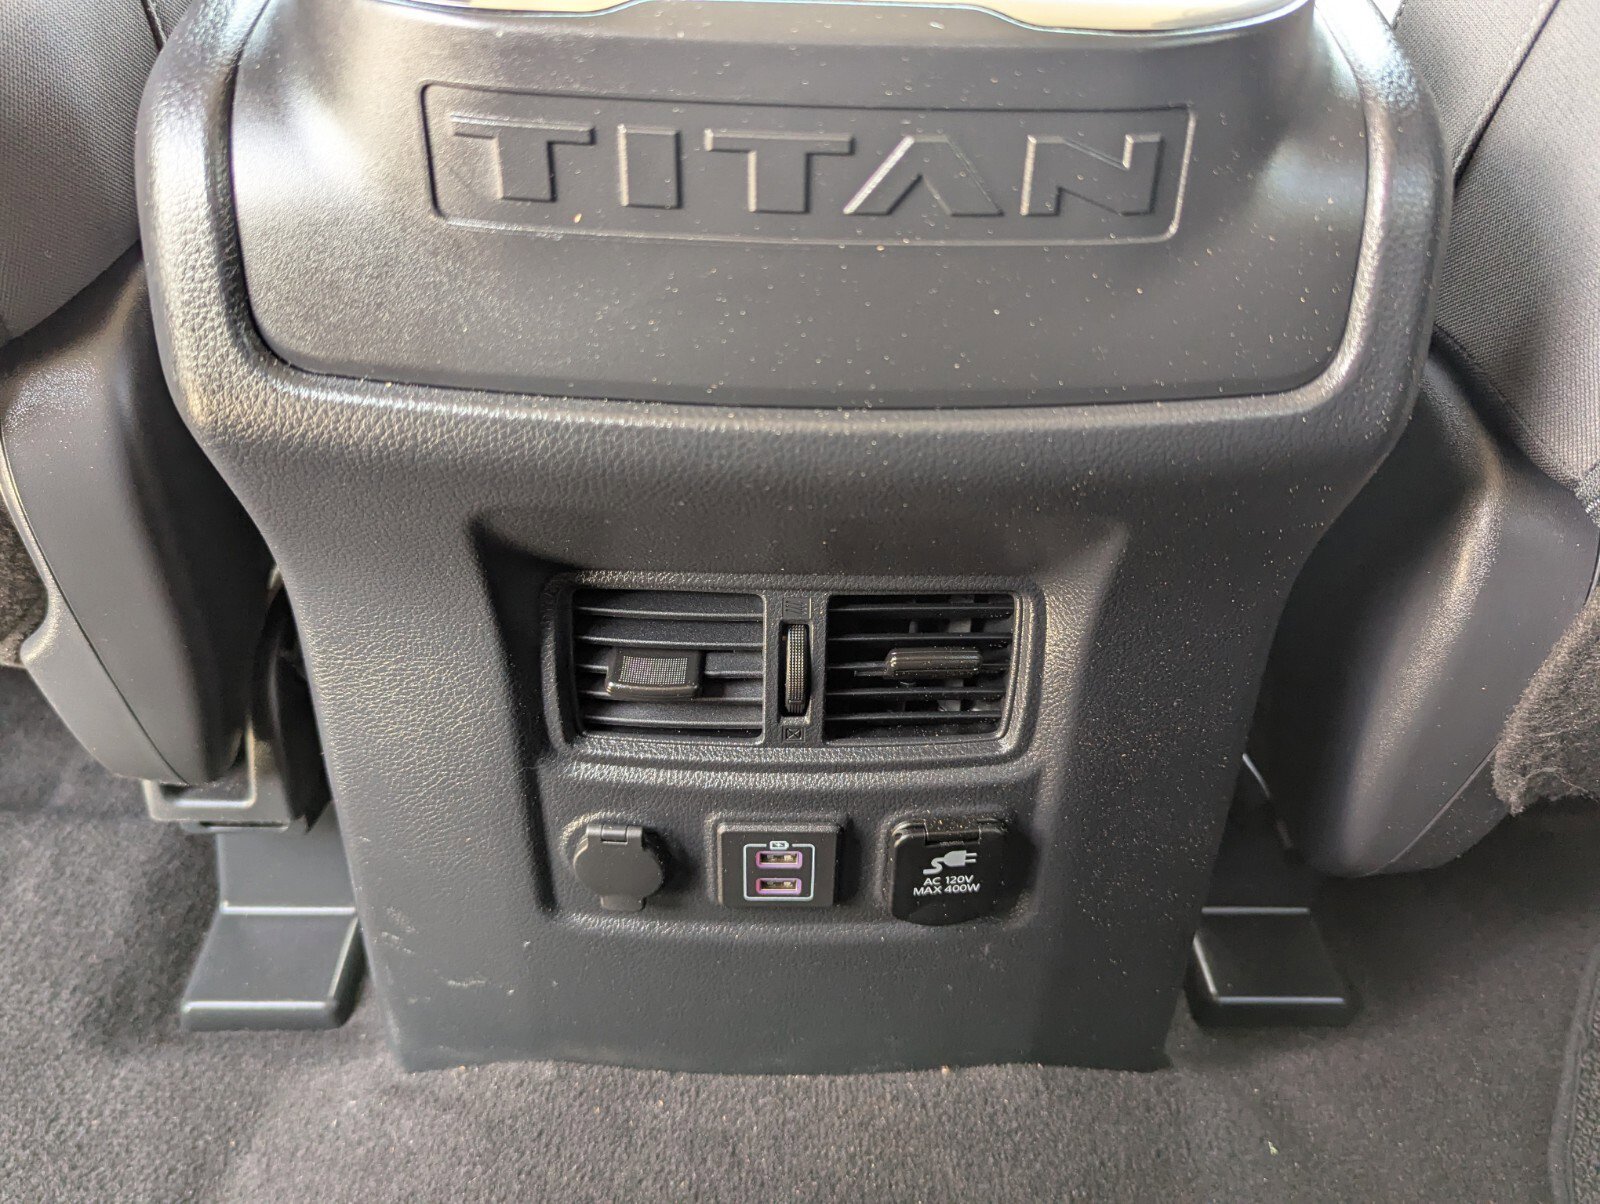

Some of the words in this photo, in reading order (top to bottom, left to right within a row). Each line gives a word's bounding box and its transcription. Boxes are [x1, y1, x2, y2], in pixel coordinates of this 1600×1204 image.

[451, 113, 1163, 216] TITAN
[923, 877, 941, 886] AC
[945, 875, 974, 884] 120V
[913, 886, 942, 896] MAX
[944, 883, 980, 893] 400W
